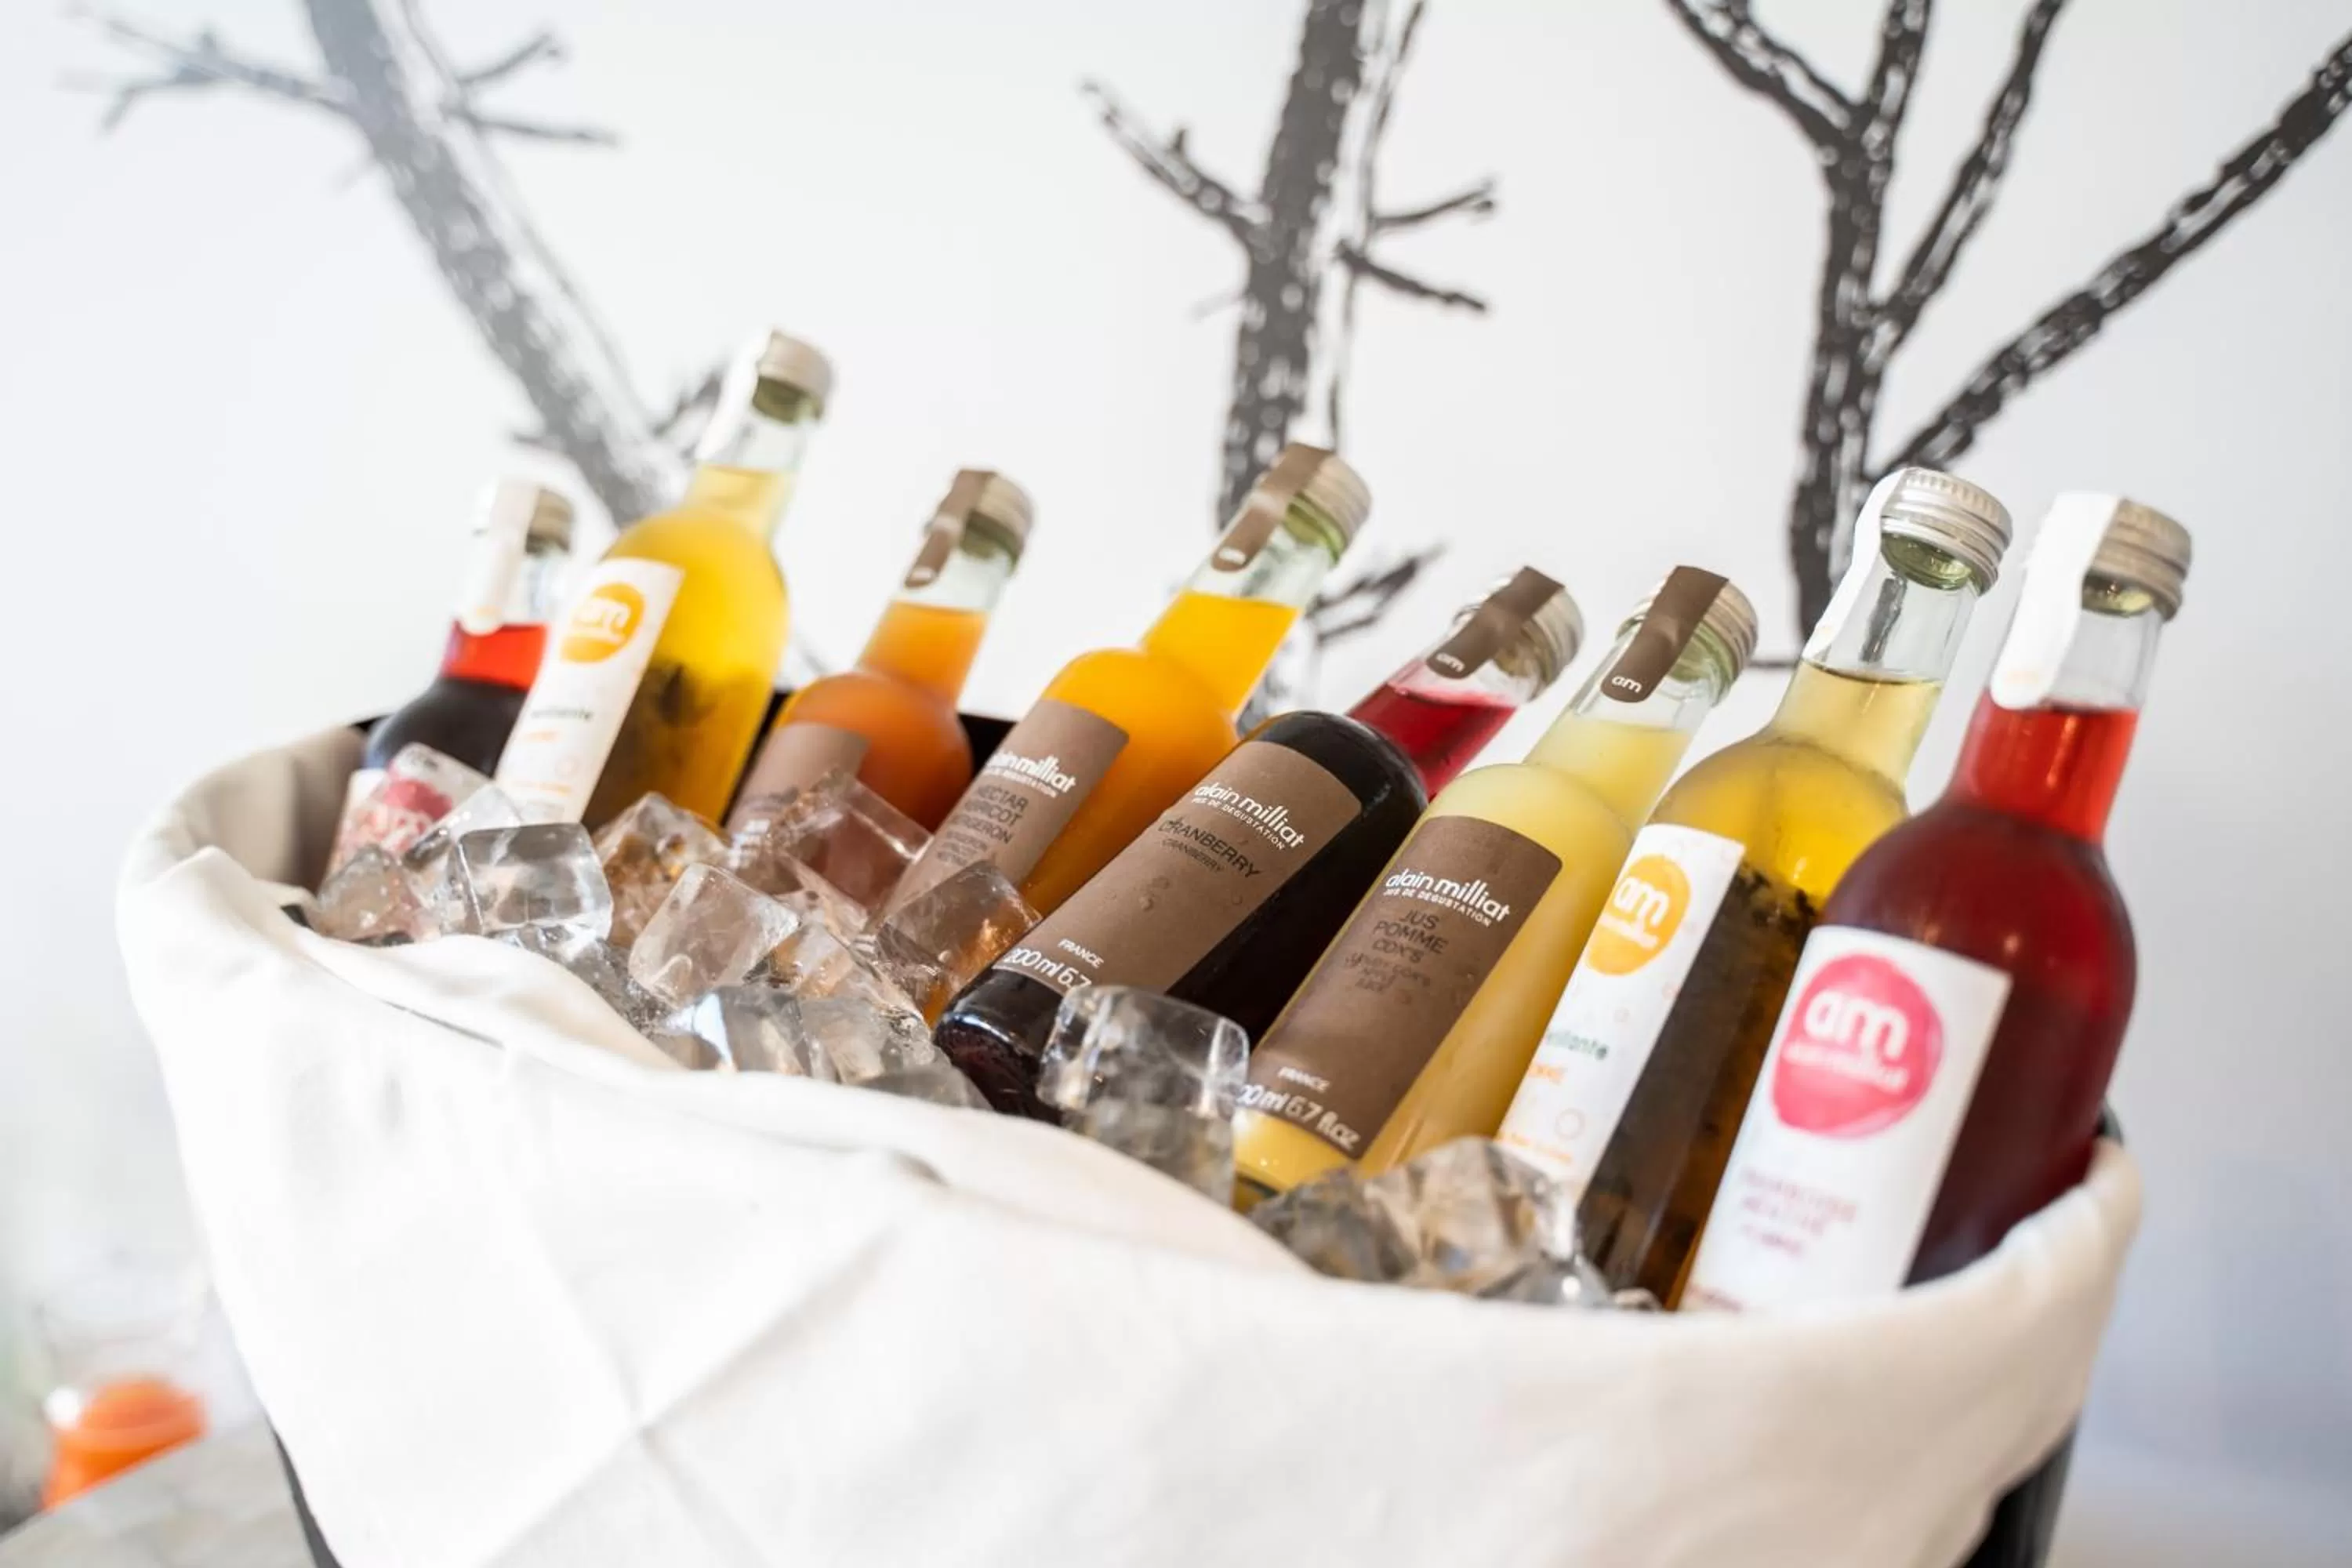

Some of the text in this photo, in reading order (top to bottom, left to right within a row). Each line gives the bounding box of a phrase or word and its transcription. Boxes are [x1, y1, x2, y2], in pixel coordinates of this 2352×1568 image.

[1436, 652, 1465, 673] am
[1611, 674, 1643, 694] am
[1195, 782, 1305, 848] alain milliat
[1158, 818, 1261, 878] CRANBERRY
[1385, 868, 1510, 922] alain milliat
[1613, 876, 1669, 928] am
[1373, 920, 1449, 954] POMME
[1399, 909, 1439, 931] JUS
[1058, 938, 1104, 969] FRANCE
[1805, 990, 1908, 1062] am
